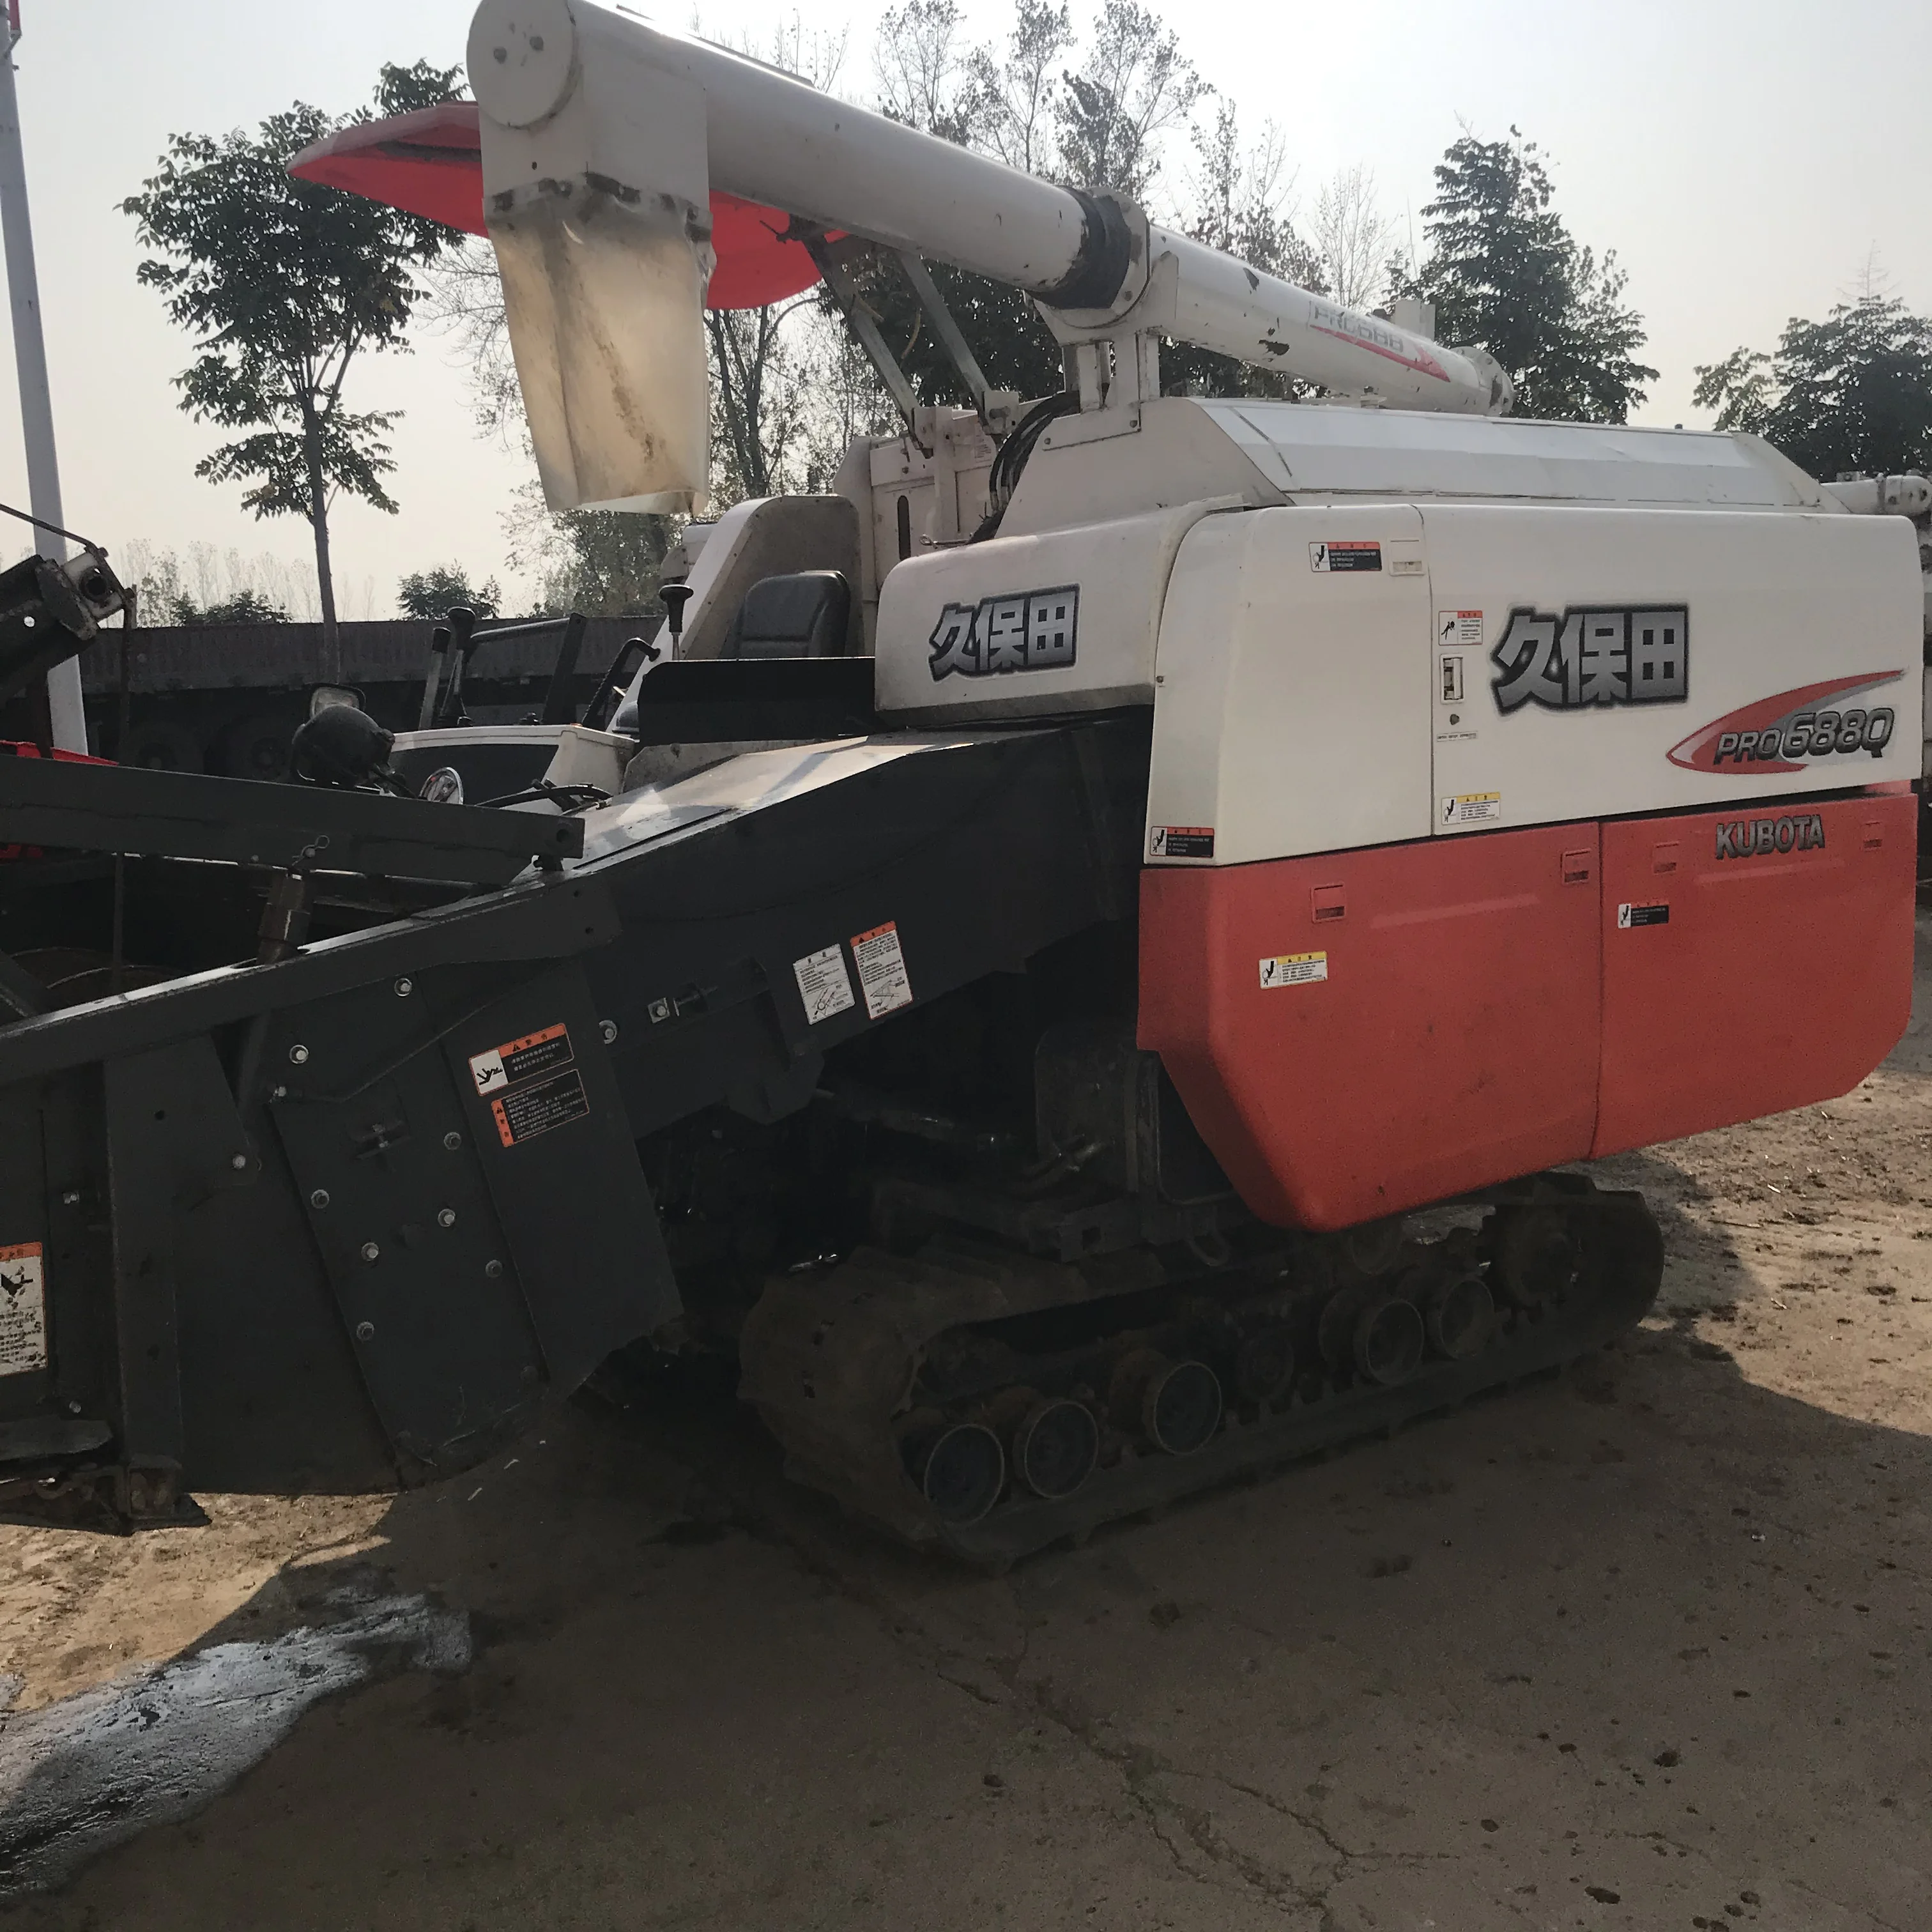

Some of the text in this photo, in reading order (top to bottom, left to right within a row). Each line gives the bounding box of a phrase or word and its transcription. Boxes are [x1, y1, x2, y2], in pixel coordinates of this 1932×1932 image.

[929, 583, 1080, 682] 久保田
[1490, 603, 1689, 716] 久保田
[1713, 707, 1894, 765] PRO688Q
[1715, 814, 1825, 860] KUBOTA
